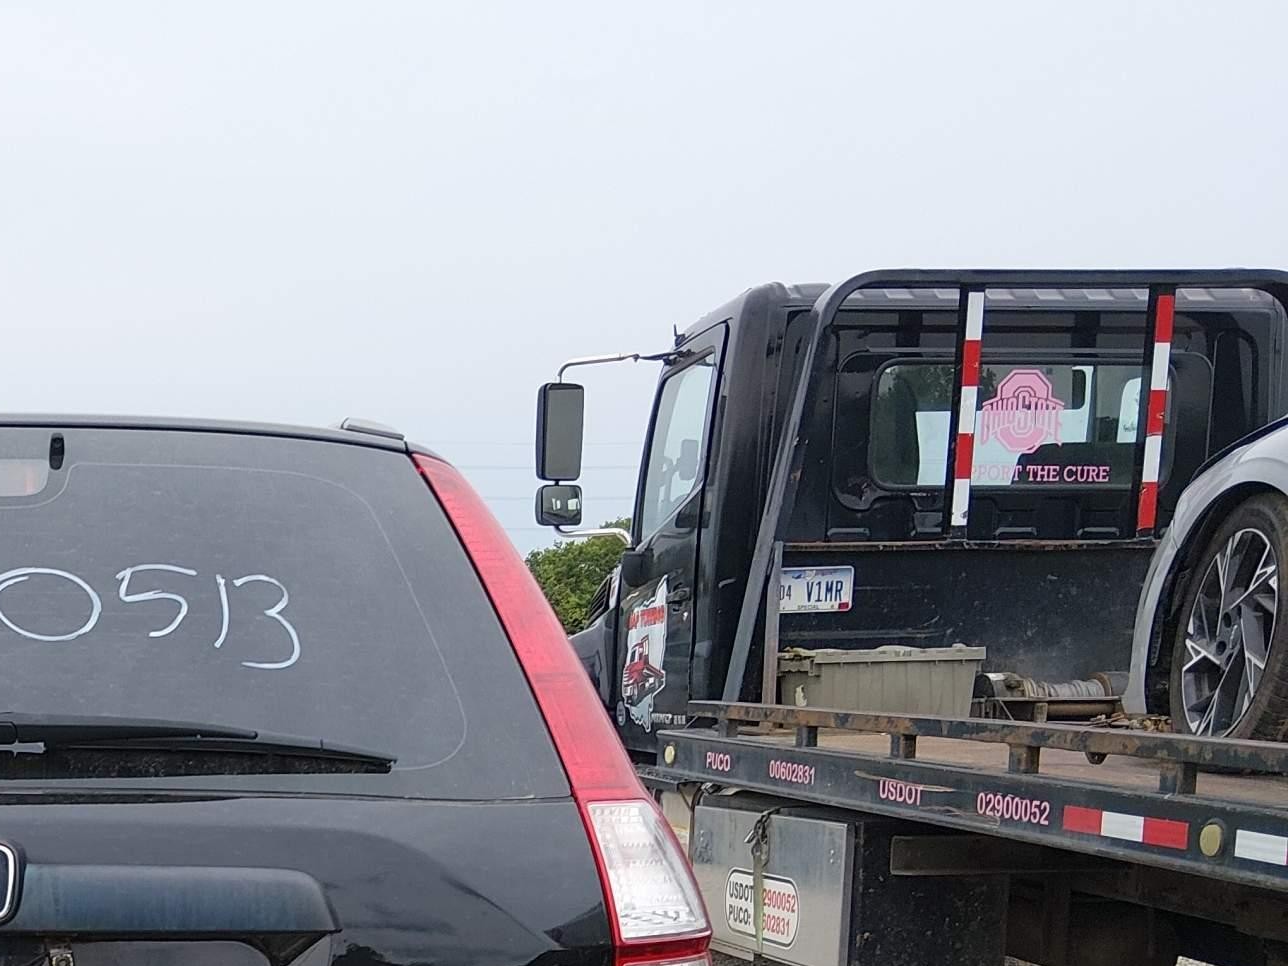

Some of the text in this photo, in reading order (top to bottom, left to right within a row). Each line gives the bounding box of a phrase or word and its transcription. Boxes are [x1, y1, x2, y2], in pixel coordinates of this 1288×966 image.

[1026, 465, 1060, 482] THE
[1063, 465, 1110, 483] CURE
[806, 580, 844, 603] V1MR
[706, 751, 816, 785] PUCO 00602831
[879, 779, 1050, 826] USDOT 02900052
[761, 887, 796, 913] 2900052
[728, 903, 751, 926] PUCO:
